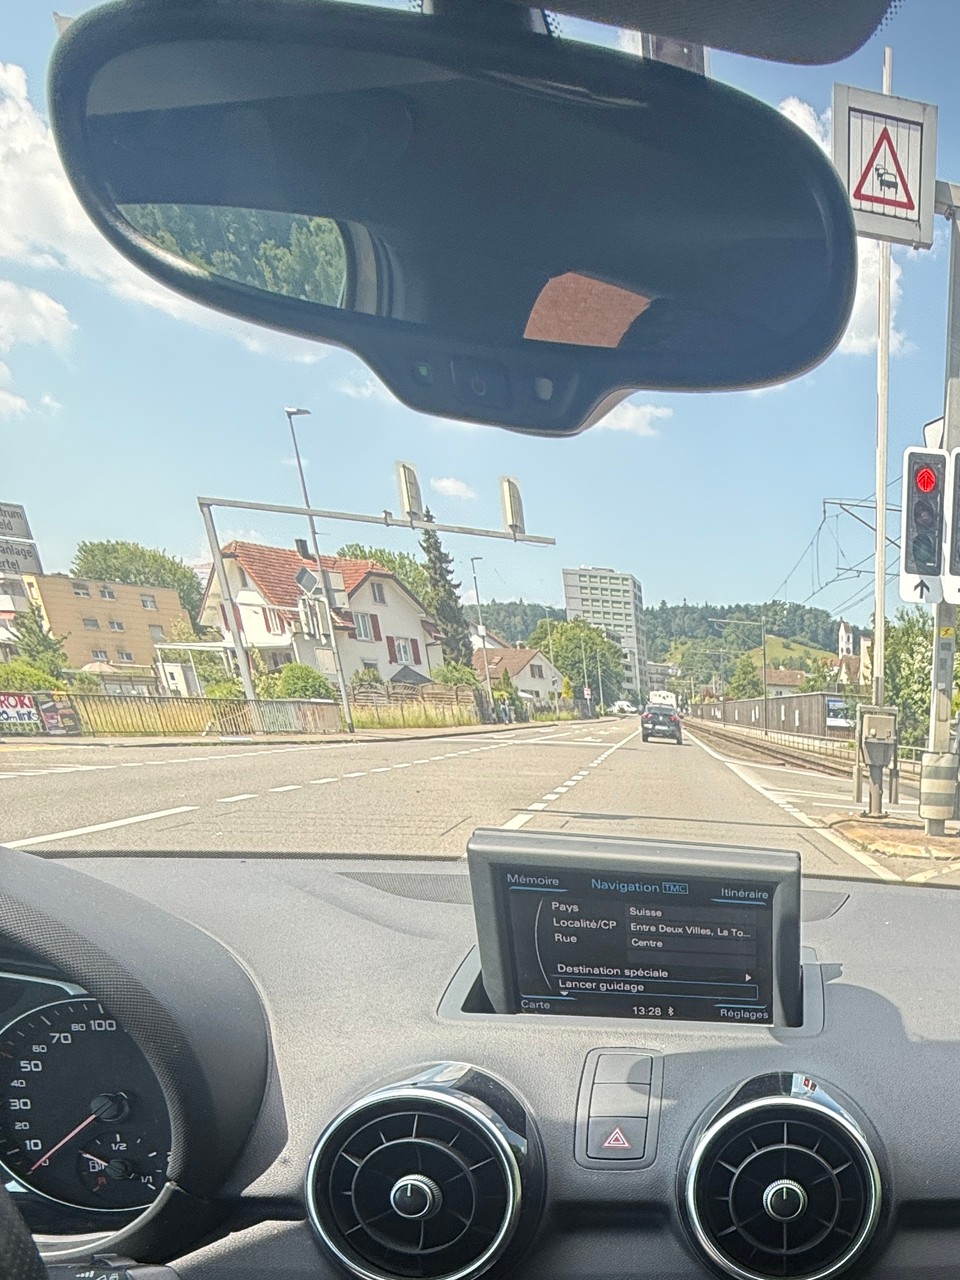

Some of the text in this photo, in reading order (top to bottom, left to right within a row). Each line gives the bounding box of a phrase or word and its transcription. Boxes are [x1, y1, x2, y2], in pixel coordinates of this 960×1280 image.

[507, 873, 560, 886] Mémoire
[591, 878, 687, 894] Navigation TMC
[720, 887, 769, 899] Itinéraire
[551, 901, 579, 913] Pays
[629, 907, 662, 917] Suisse
[553, 917, 617, 930] Localité/CP
[630, 922, 656, 933] Entre
[659, 924, 684, 934] Deux
[685, 924, 715, 937] Villes,
[717, 927, 729, 937] La
[554, 933, 578, 944] Rue
[631, 938, 663, 948] Centre
[557, 964, 669, 979] Destination spéciale
[558, 979, 645, 993] Lancer guidage
[521, 1000, 551, 1010] Carte
[632, 1006, 662, 1016] 13:28
[720, 1008, 769, 1021] Réglages
[71, 1022, 86, 1031] 80
[89, 1019, 117, 1031] 100
[50, 1033, 72, 1044] 70
[32, 1044, 48, 1053] 60
[20, 1061, 43, 1072] 50
[10, 1079, 26, 1088] 40
[9, 1098, 31, 1110] 30
[15, 1121, 29, 1130] 20
[25, 1139, 42, 1150] 10
